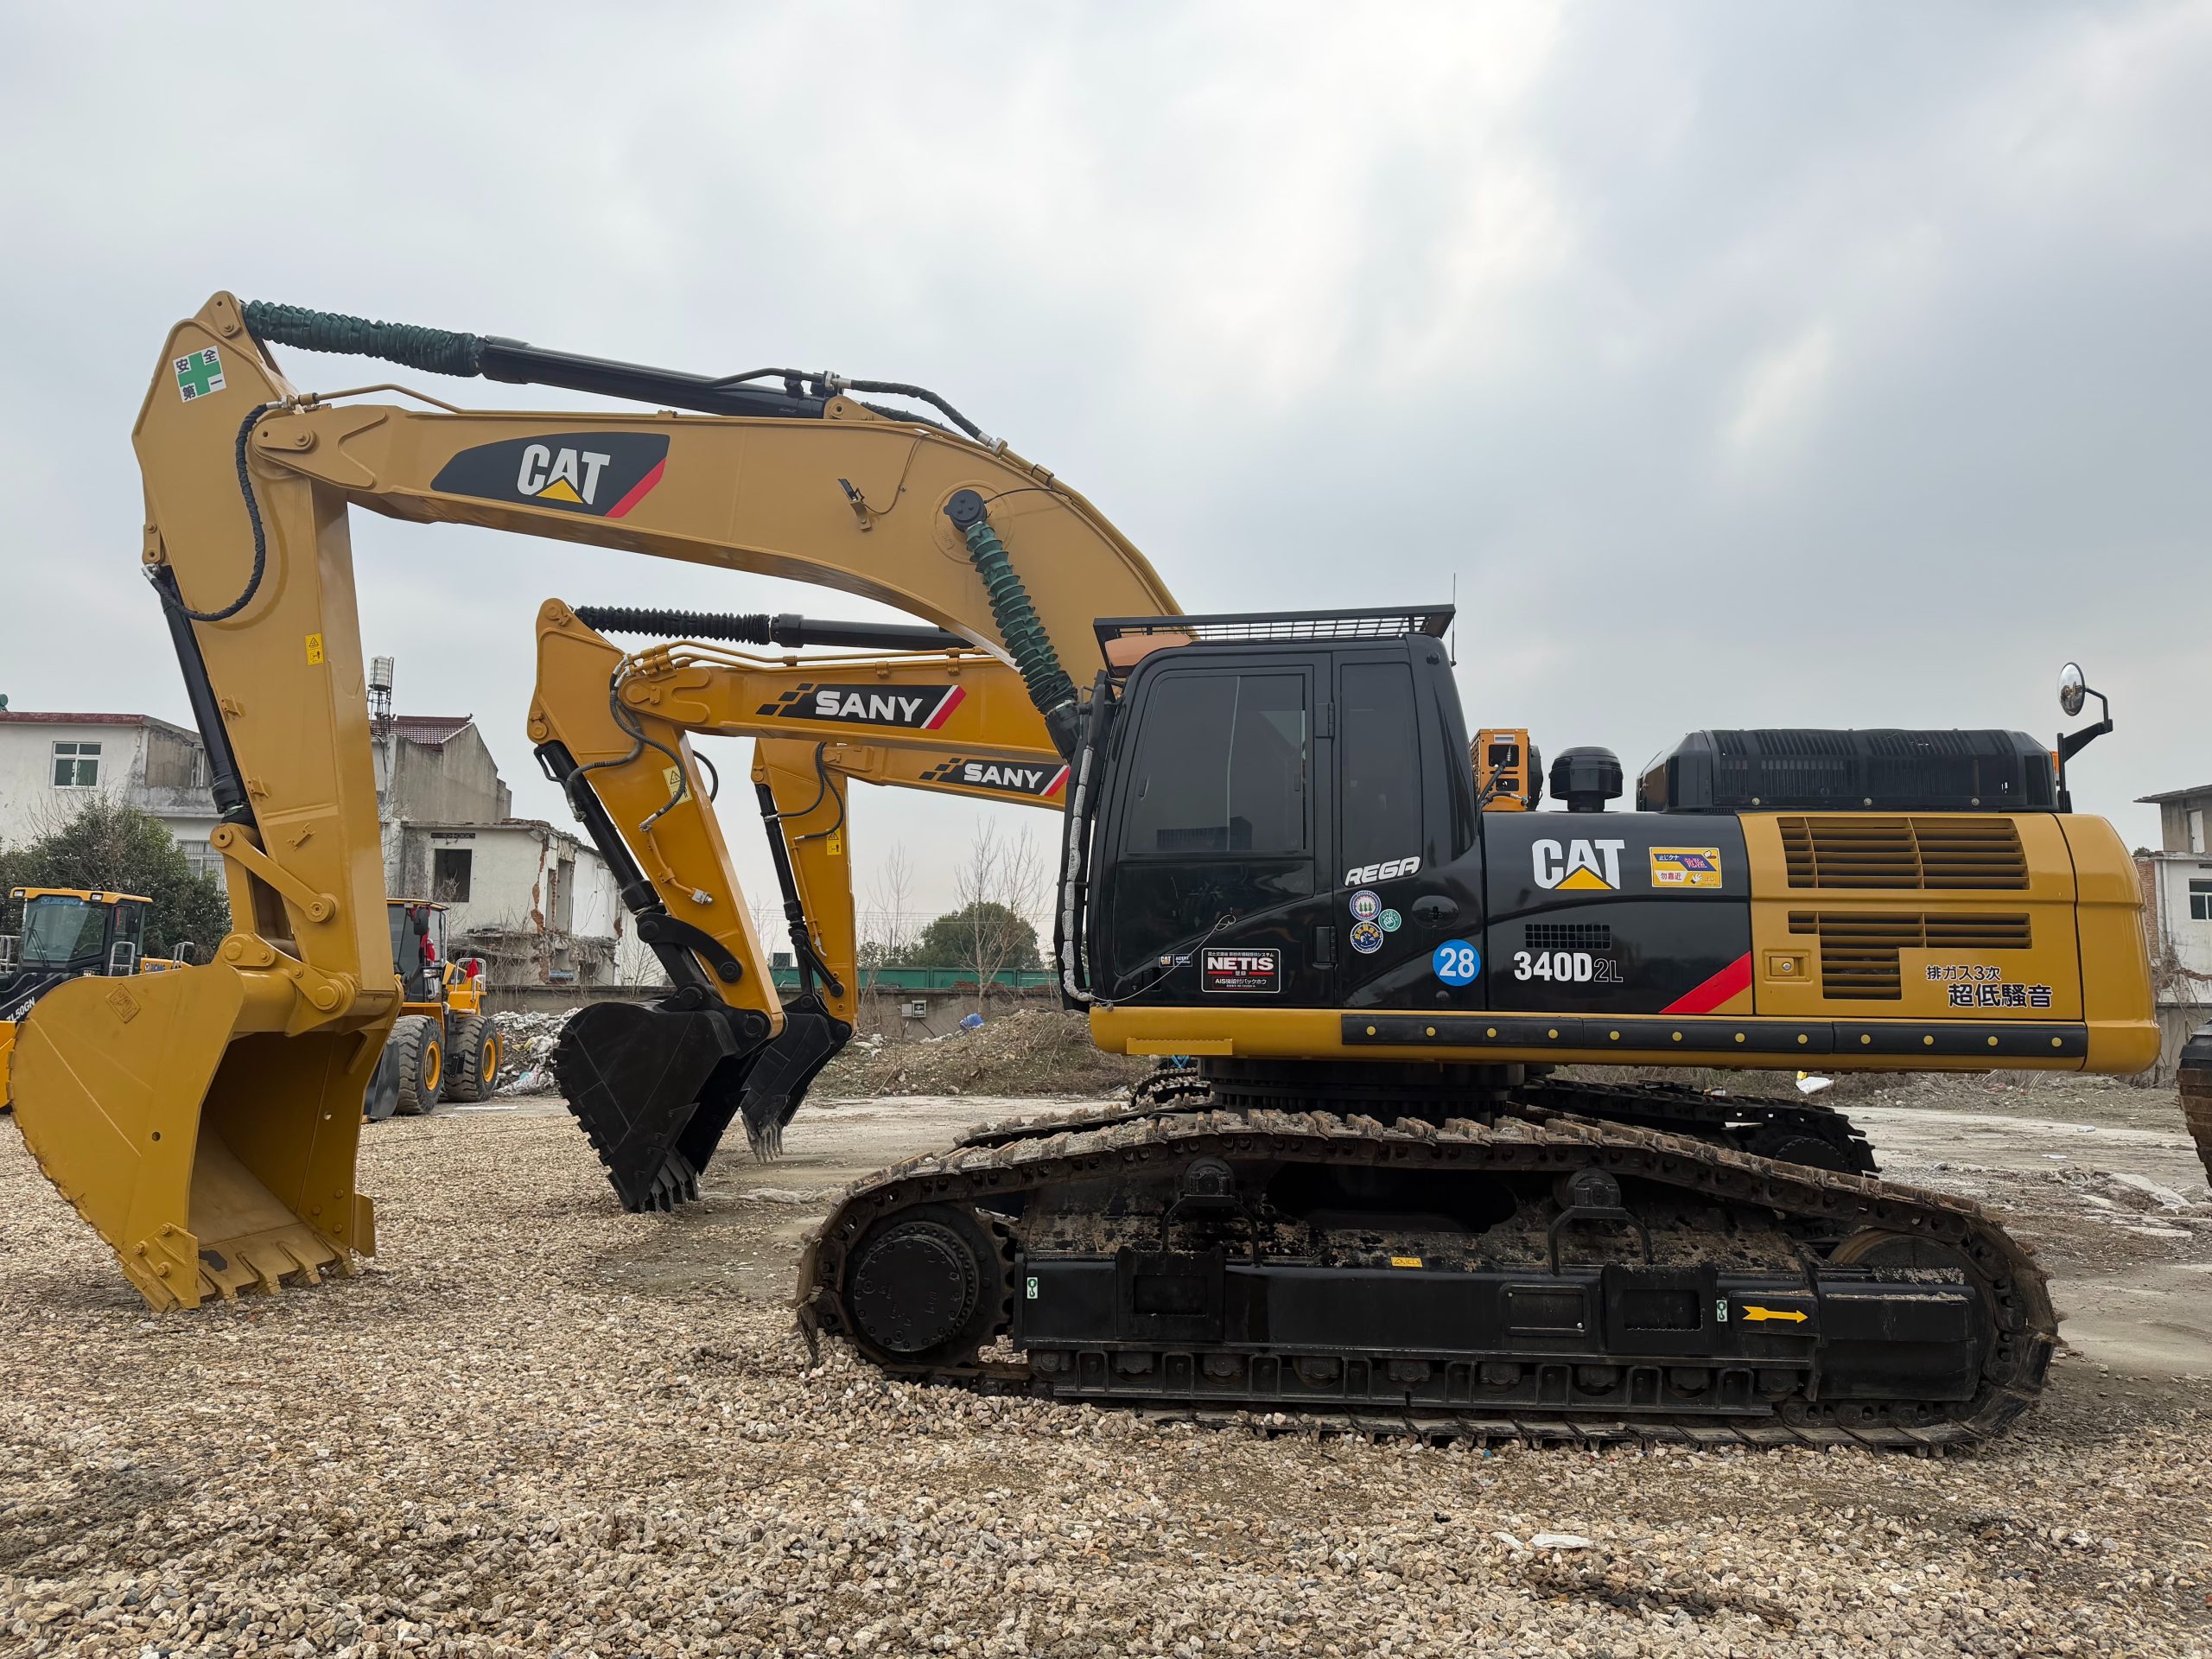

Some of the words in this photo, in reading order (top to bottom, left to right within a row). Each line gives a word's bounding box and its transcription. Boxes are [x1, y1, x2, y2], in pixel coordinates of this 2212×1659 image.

[517, 443, 611, 505] CAT
[815, 690, 924, 722] SANY
[963, 763, 1044, 789] SANY
[1344, 855, 1421, 887] REGA
[1531, 838, 1625, 890] CAT
[1207, 957, 1274, 971] NETIS
[1439, 947, 1475, 978] 28
[1926, 965, 2001, 981] 排ガス3次
[1947, 983, 2053, 1008] 超低騒音
